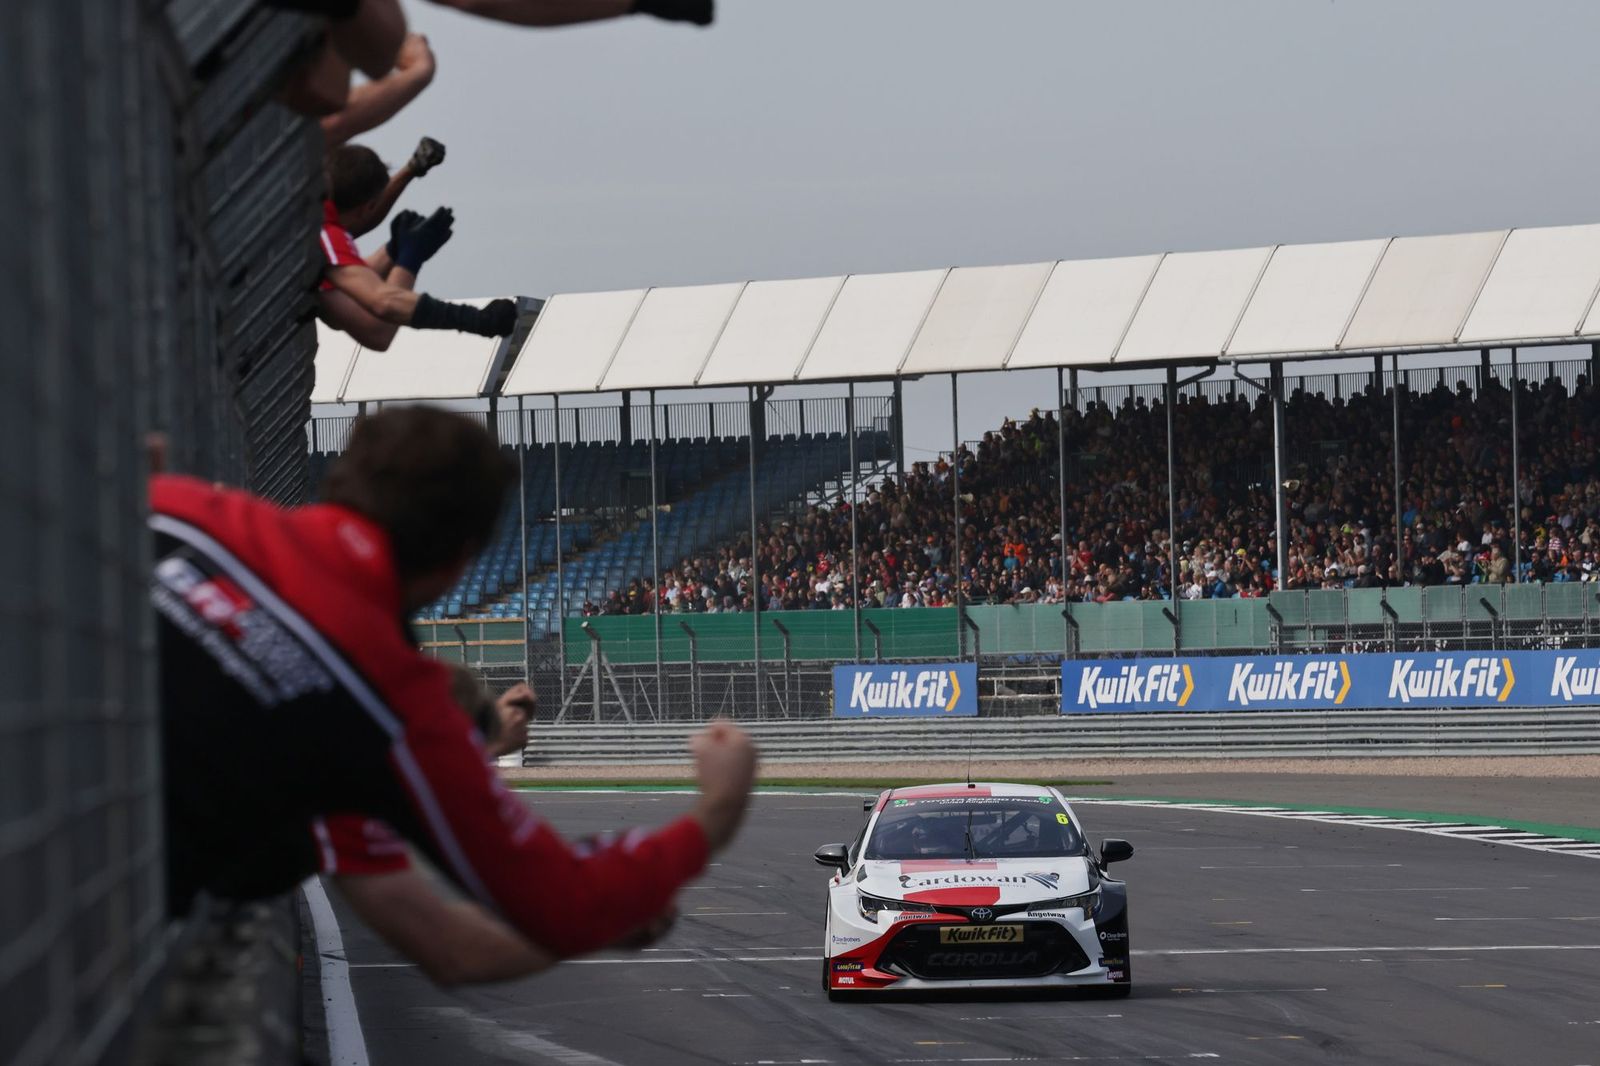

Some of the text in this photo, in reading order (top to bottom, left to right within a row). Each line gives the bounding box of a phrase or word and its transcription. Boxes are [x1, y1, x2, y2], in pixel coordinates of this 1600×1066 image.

[1055, 813, 1069, 825] 6
[899, 874, 1027, 889] Cardowan
[1027, 911, 1066, 920] Angelwax
